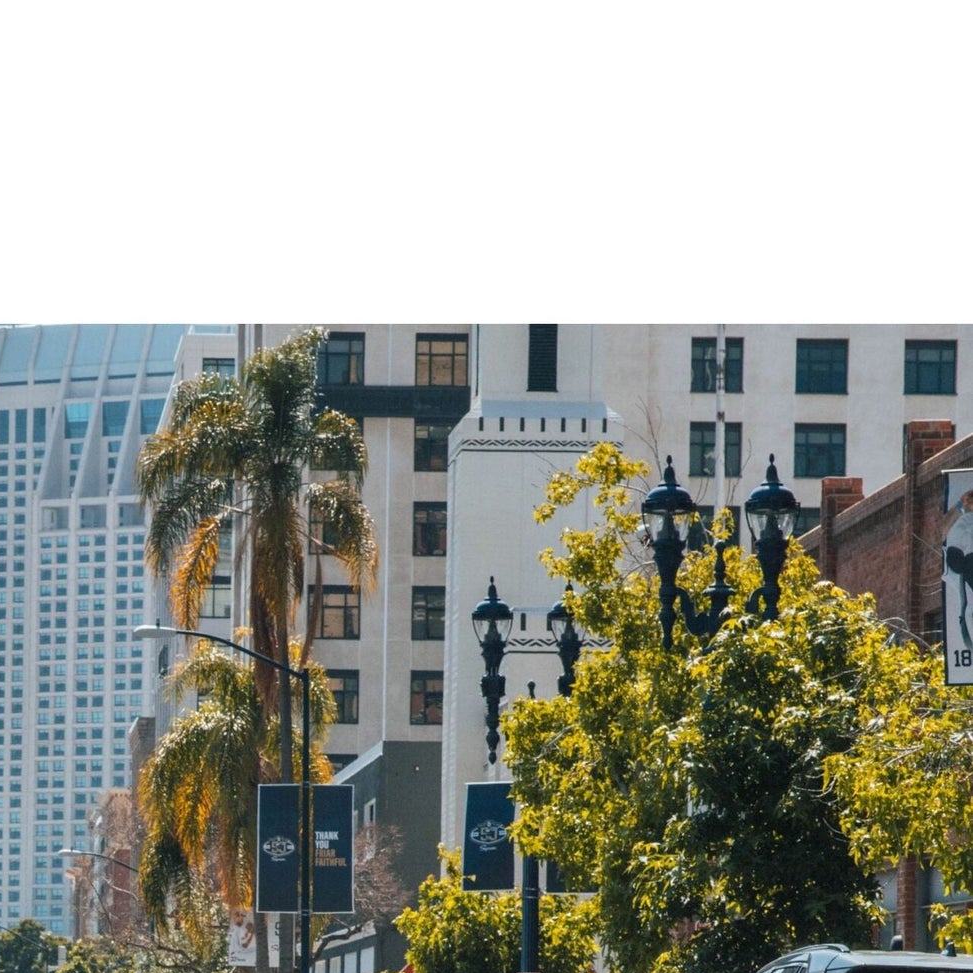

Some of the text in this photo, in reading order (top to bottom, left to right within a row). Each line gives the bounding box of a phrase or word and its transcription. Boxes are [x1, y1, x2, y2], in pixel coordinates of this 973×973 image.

[315, 831, 339, 840] THANK
[315, 840, 329, 849] YOU
[315, 849, 336, 858] FRIAR
[315, 857, 347, 867] FAITHFUL
